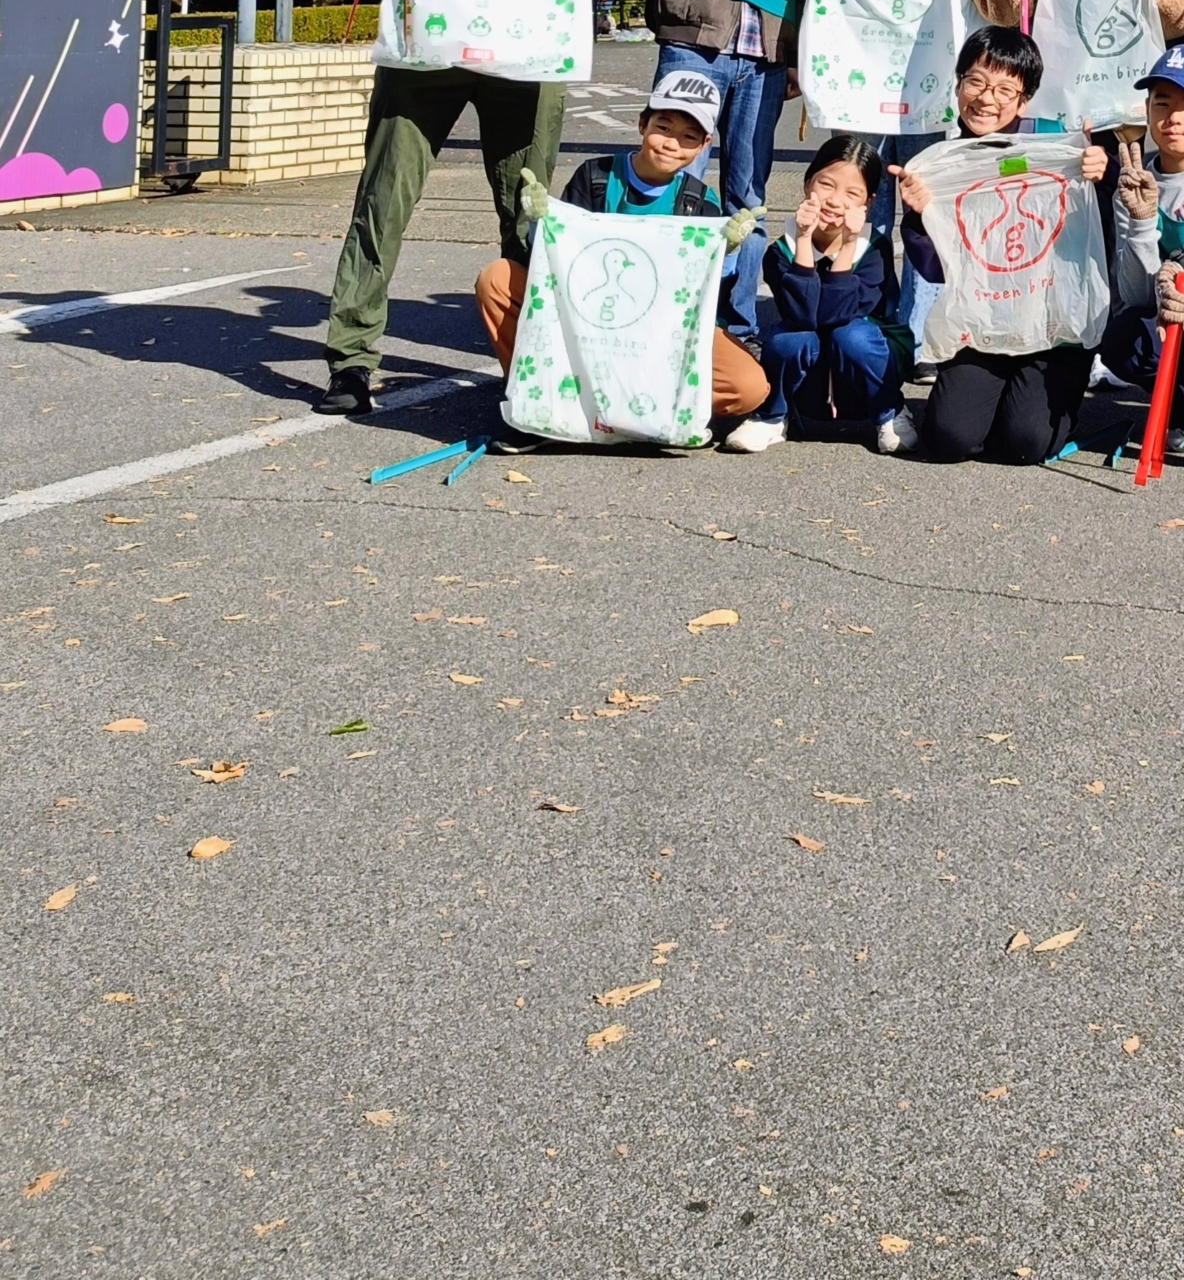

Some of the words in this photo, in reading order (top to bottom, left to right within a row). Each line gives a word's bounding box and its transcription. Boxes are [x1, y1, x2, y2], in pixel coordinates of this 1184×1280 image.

[1075, 71, 1110, 85] green
[1116, 62, 1147, 80] bird
[672, 78, 716, 100] NIKE
[974, 287, 1021, 302] green
